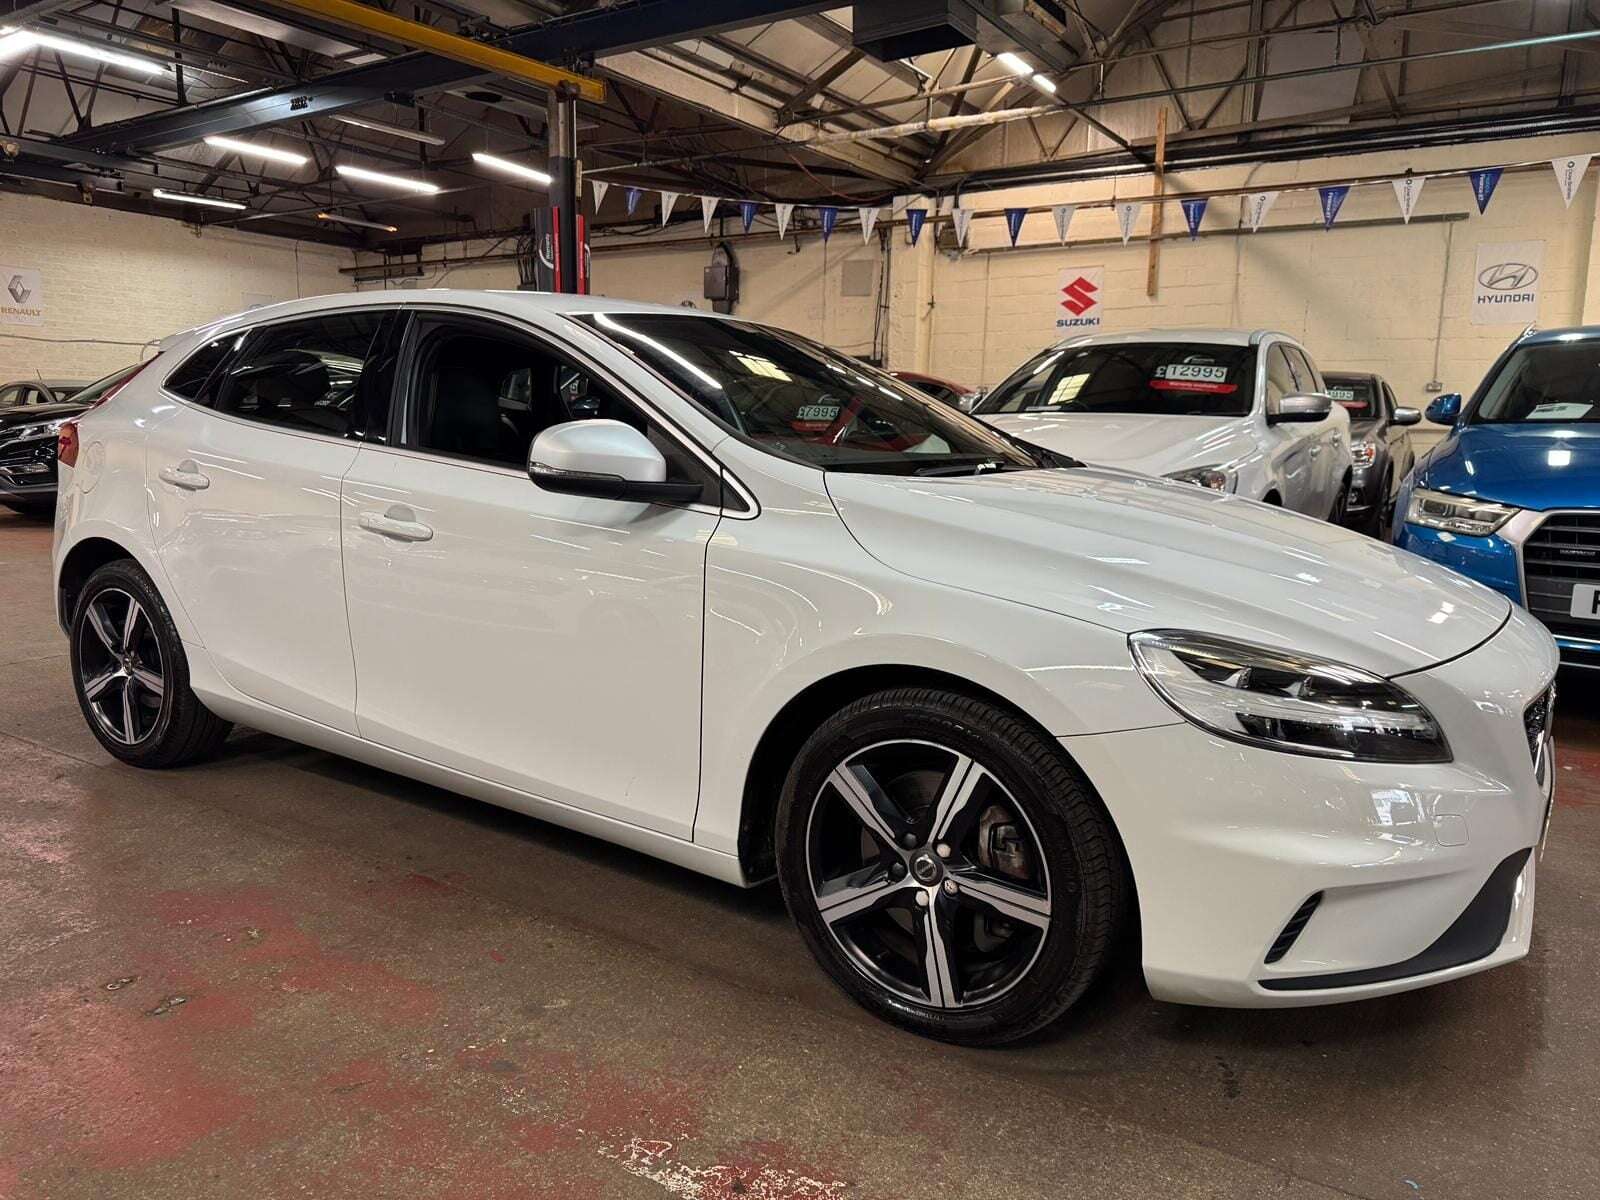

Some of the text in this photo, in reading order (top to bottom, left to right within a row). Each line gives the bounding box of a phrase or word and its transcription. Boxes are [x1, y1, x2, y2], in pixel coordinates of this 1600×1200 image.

[1477, 293, 1535, 304] HYUNDAI
[0, 306, 41, 316] RENAULT
[1056, 317, 1100, 328] SUZUKI
[1155, 365, 1225, 378] £12995
